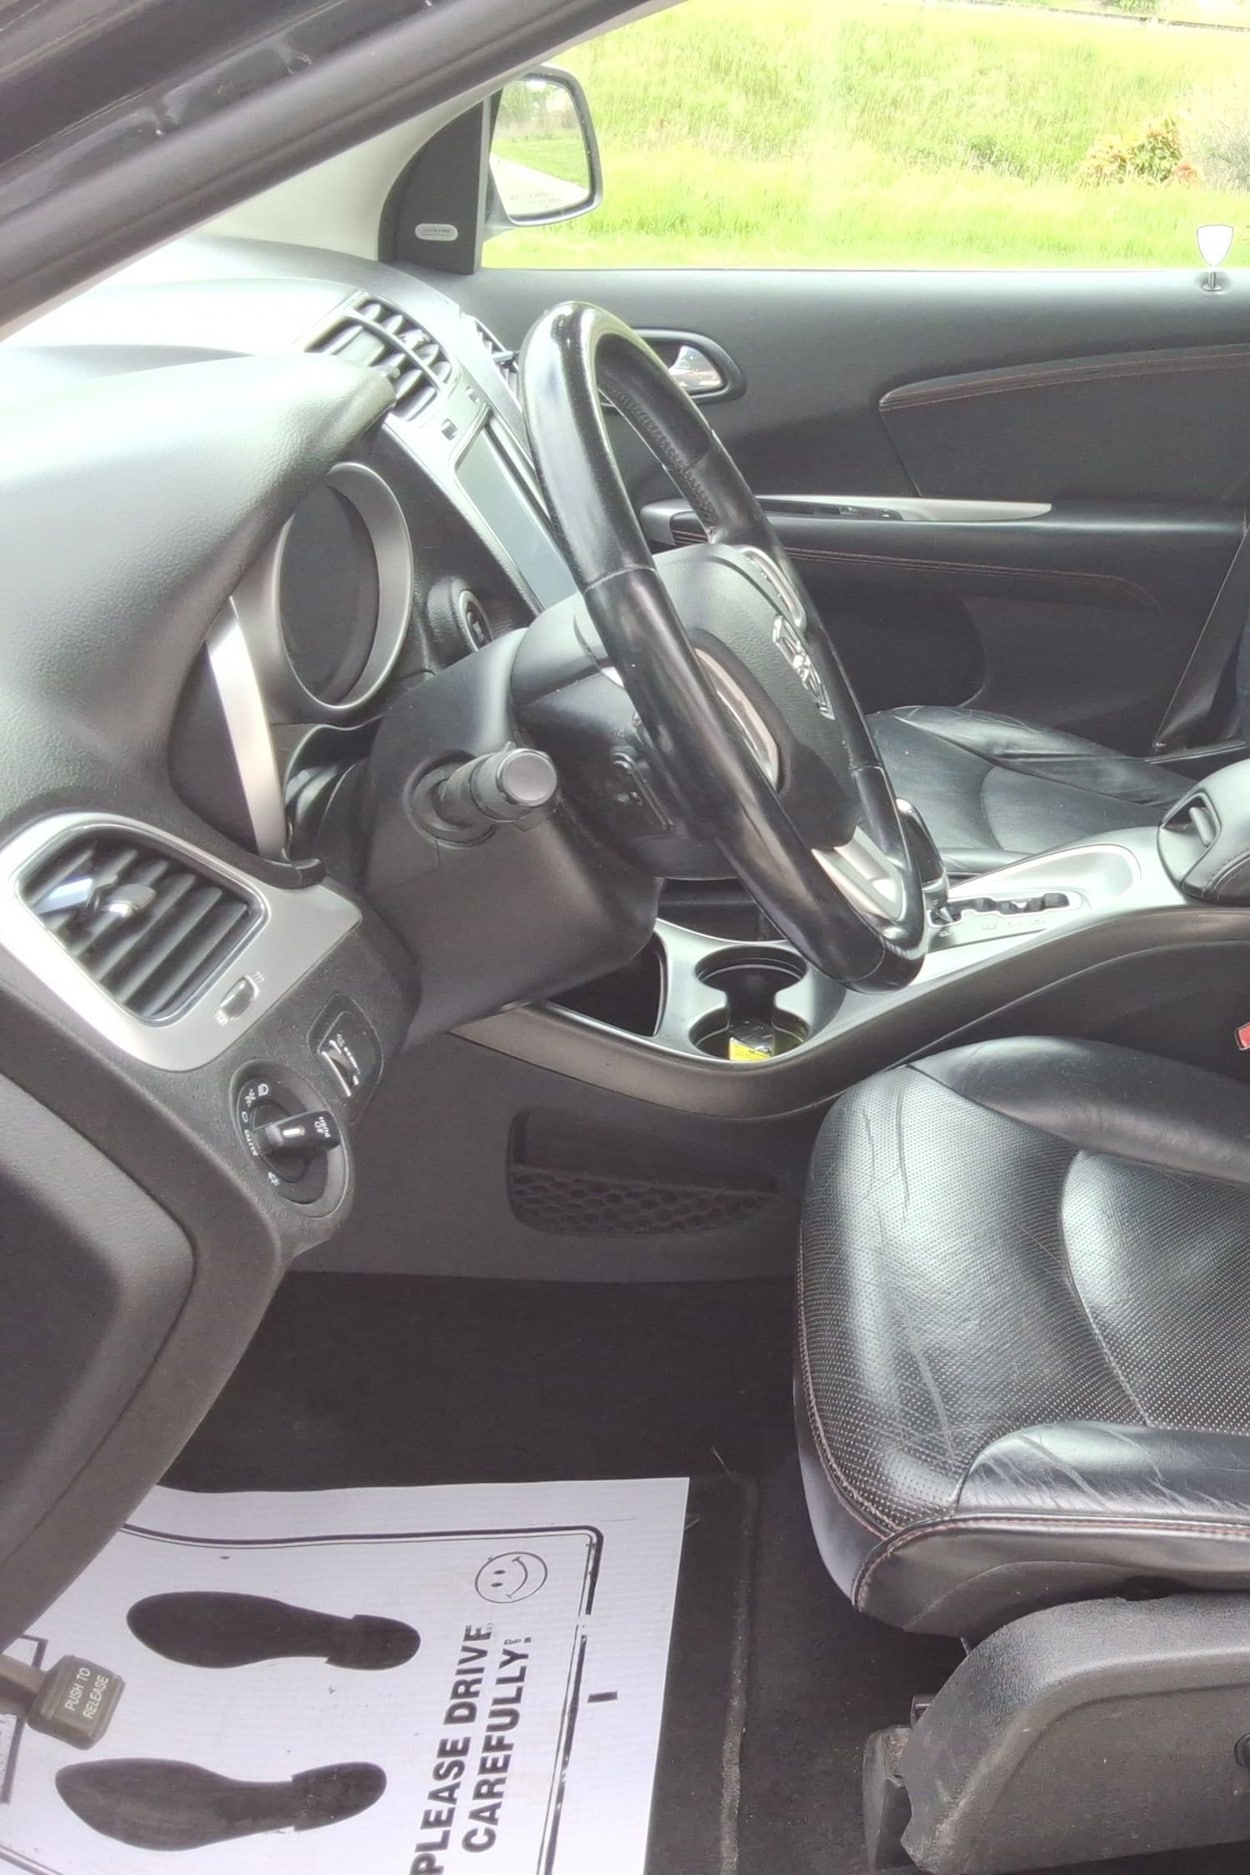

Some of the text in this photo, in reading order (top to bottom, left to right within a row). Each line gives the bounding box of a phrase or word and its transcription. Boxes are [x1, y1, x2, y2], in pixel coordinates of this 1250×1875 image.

[64, 1667, 91, 1711] PUSH TO
[82, 1674, 109, 1719] RELEASE
[409, 1625, 492, 1875] PLEASE DRIVE
